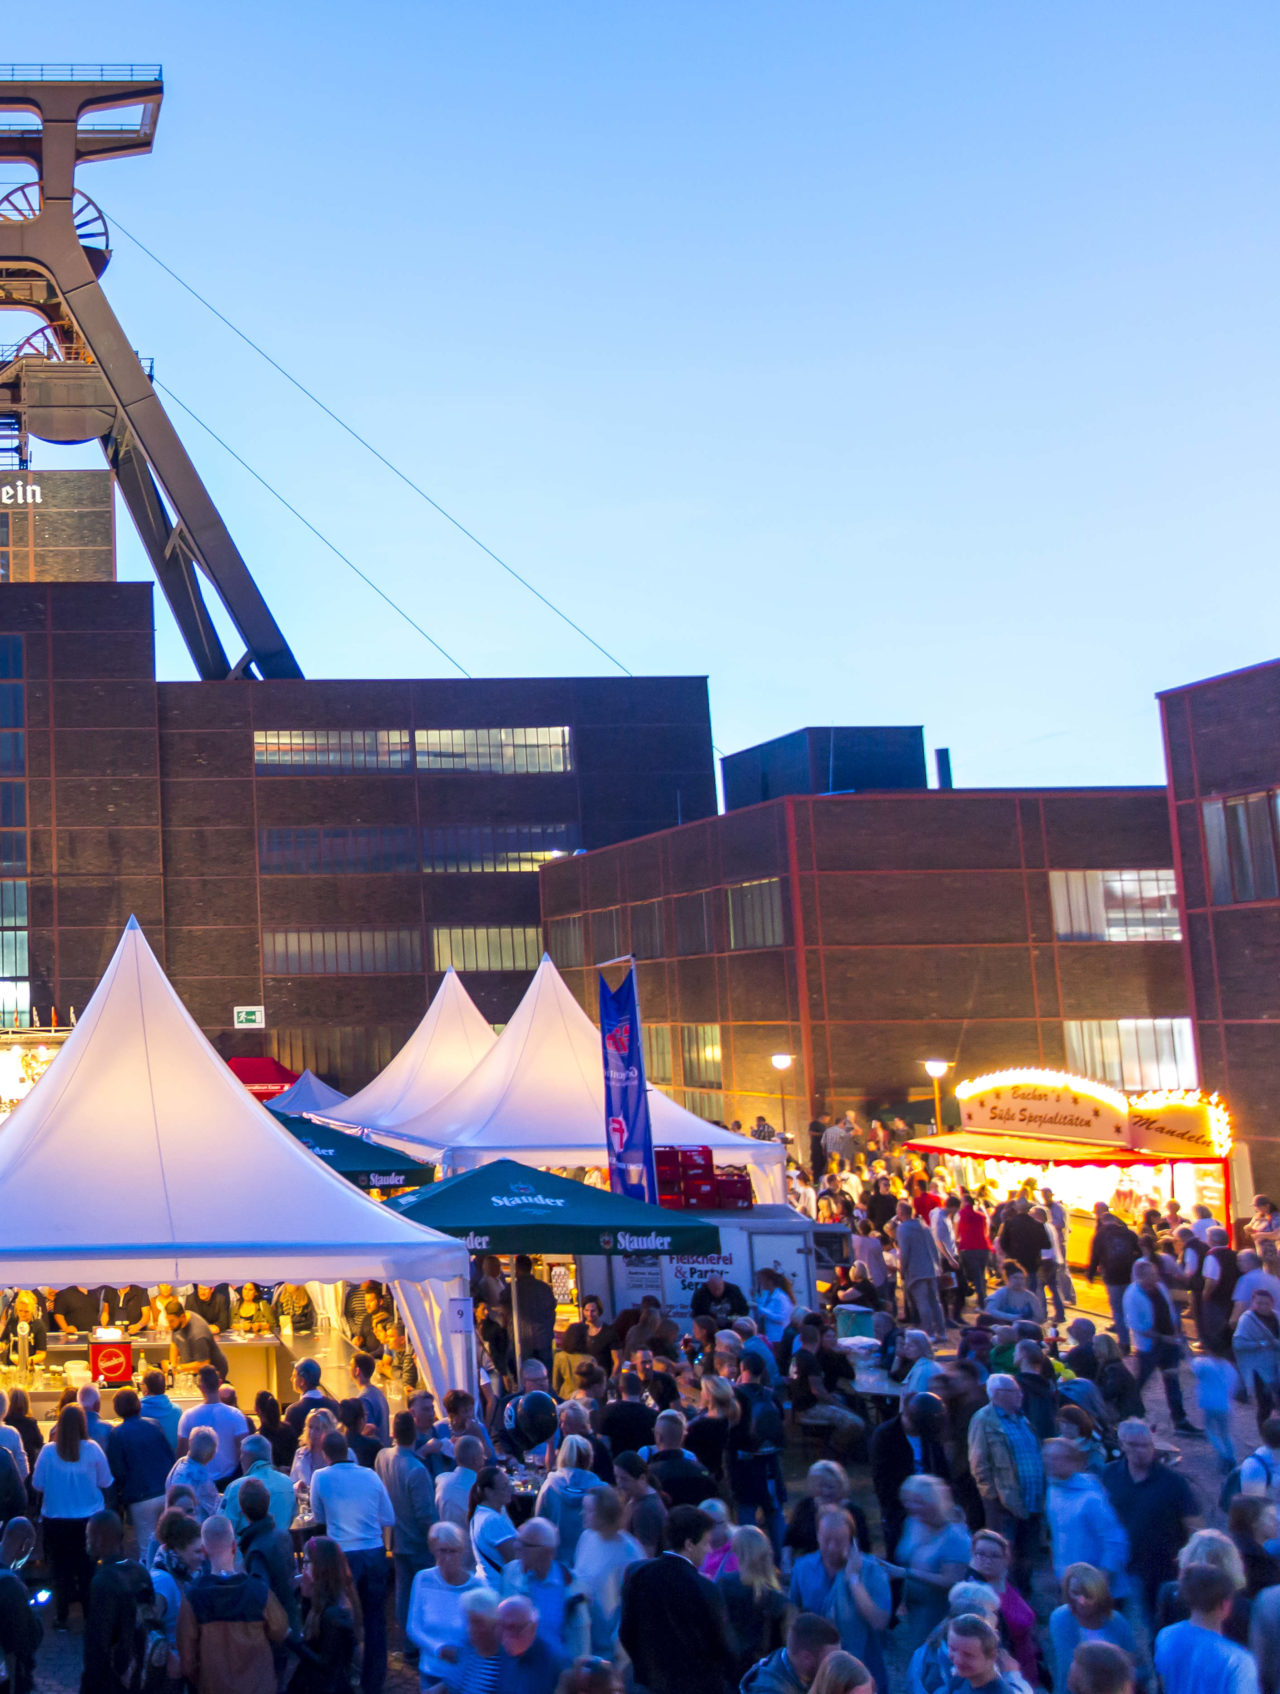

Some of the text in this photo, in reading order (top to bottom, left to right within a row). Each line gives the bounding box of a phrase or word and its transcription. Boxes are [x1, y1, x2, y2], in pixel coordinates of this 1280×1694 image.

[1018, 1107, 1092, 1128] Spezialitäten
[1132, 1114, 1212, 1148] Mandeln
[369, 1172, 405, 1187] Stauder
[490, 1194, 566, 1207] Stauder
[617, 1231, 672, 1252] Stauder
[669, 1253, 733, 1265] Fleischerei
[674, 1266, 687, 1280] &
[457, 1309, 464, 1319] 9
